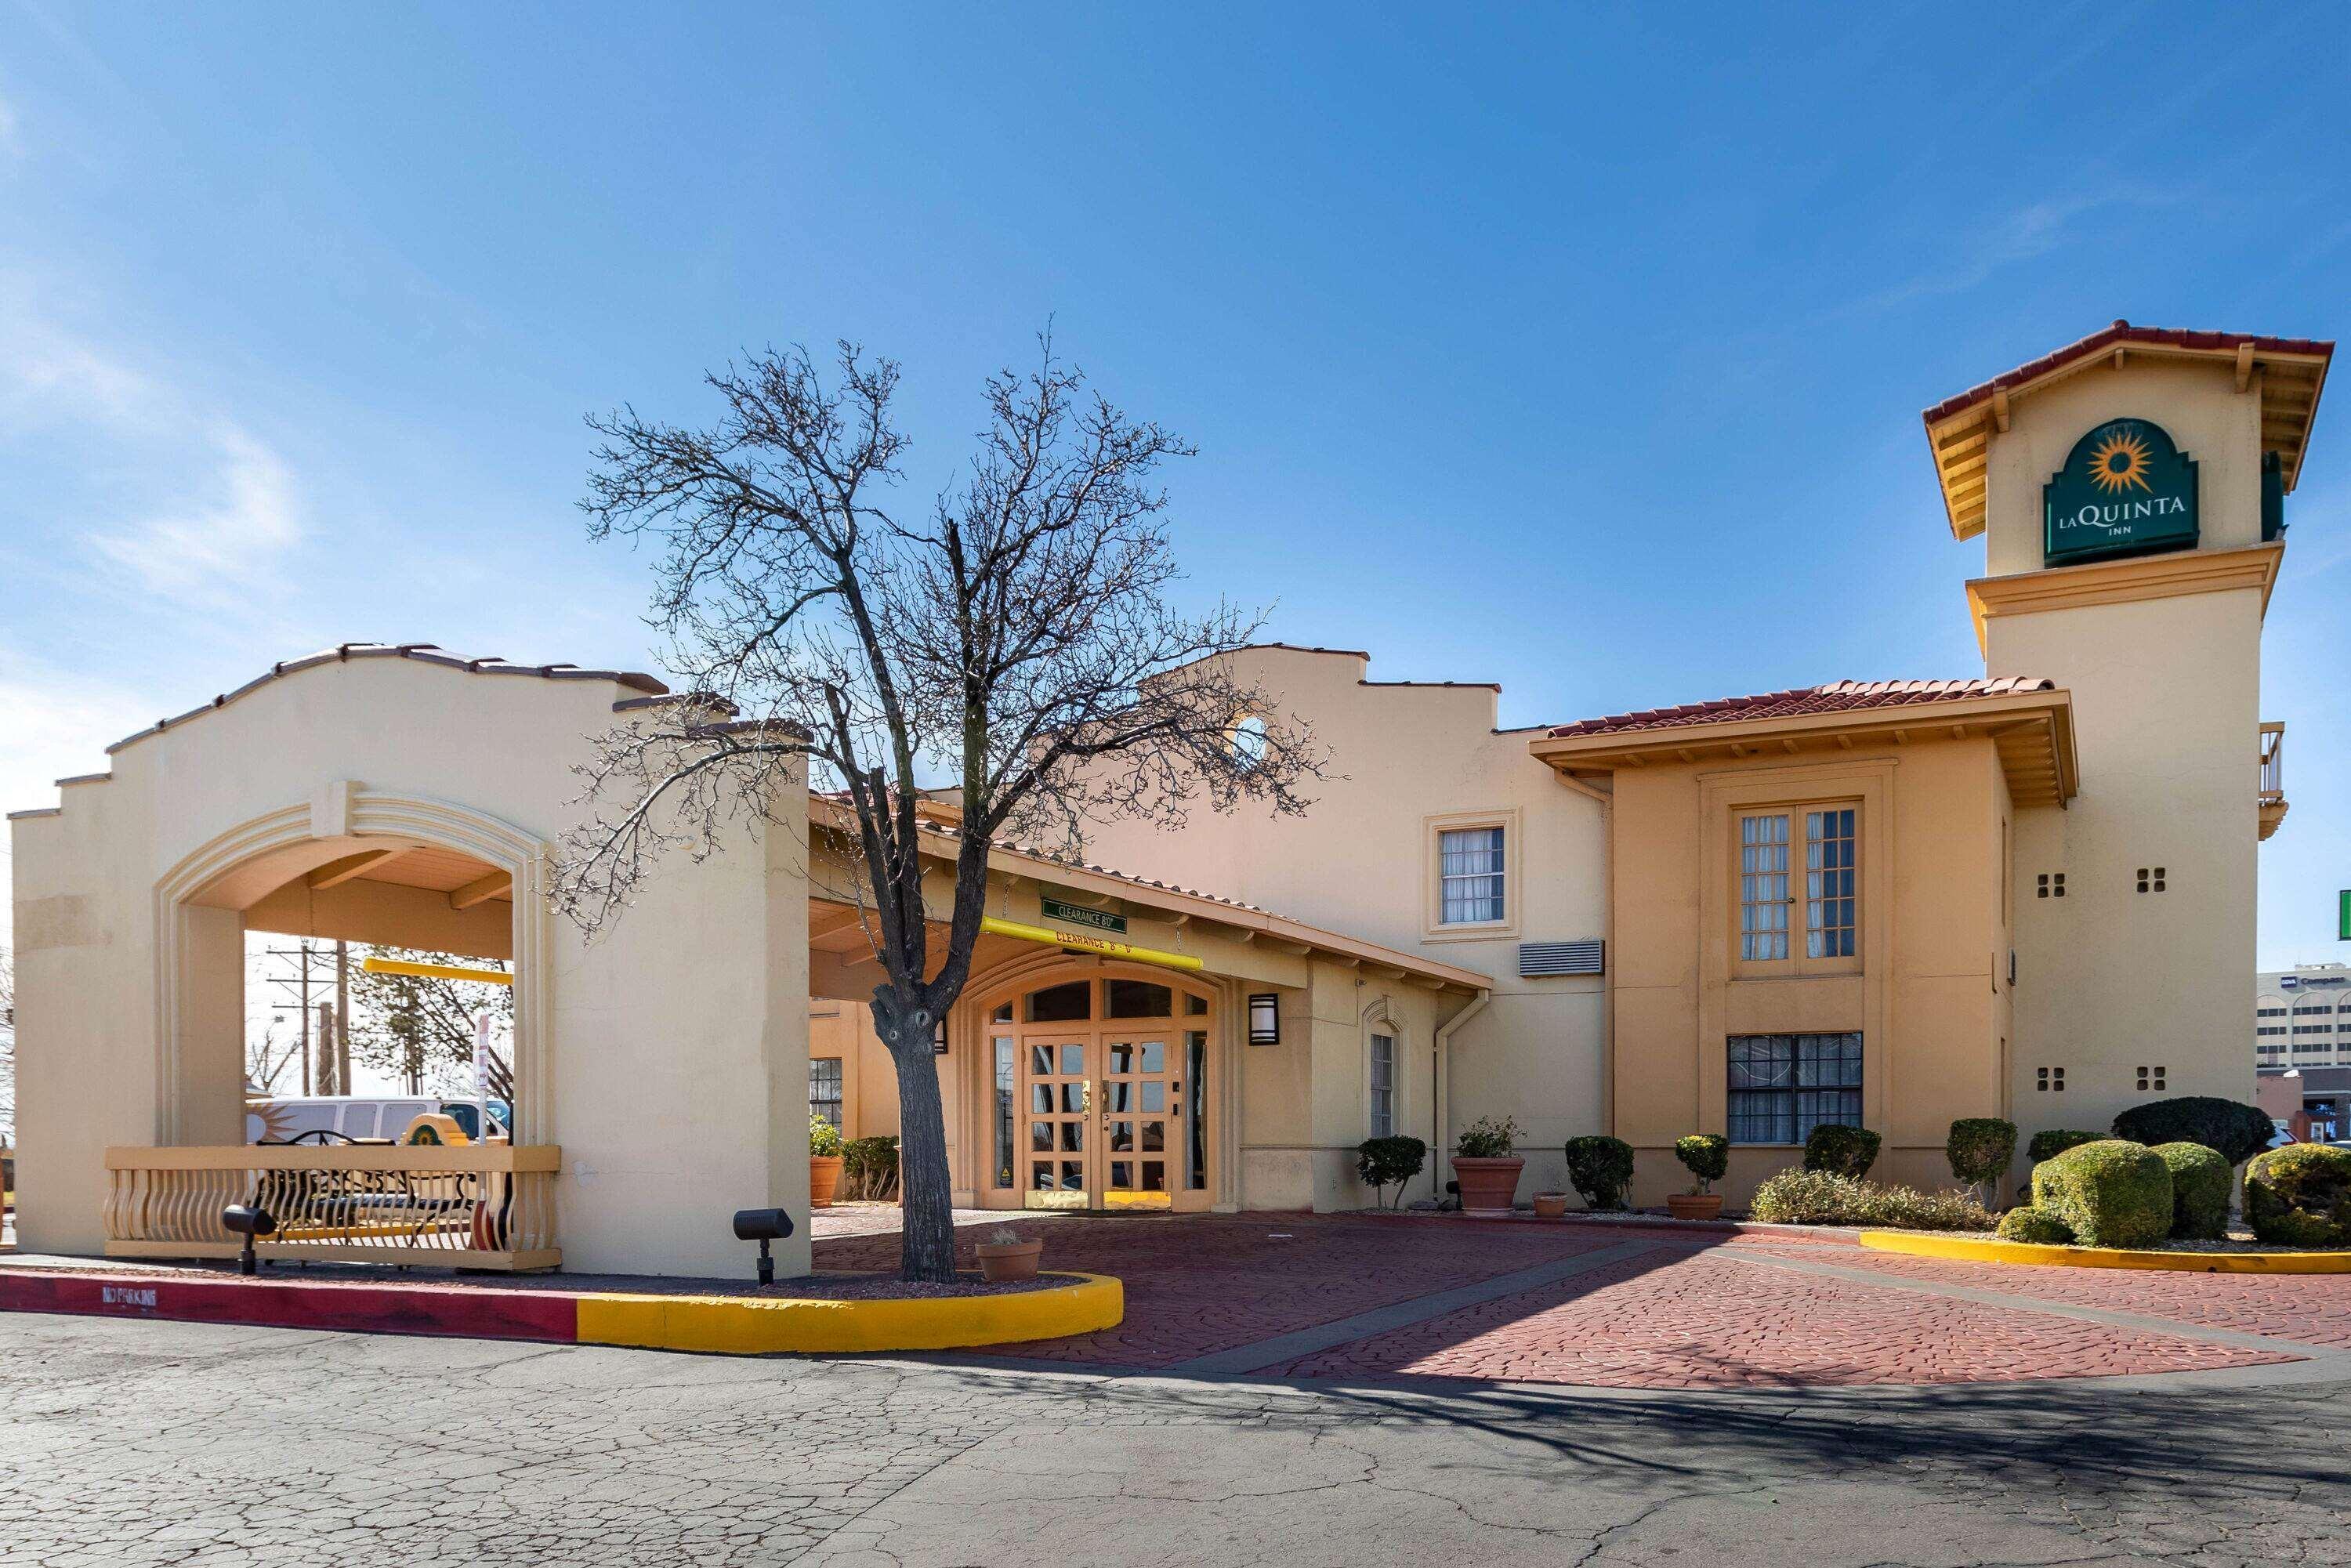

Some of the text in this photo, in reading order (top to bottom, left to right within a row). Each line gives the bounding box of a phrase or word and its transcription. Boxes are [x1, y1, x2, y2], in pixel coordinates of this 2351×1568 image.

[2059, 496, 2186, 529] LA QUINTA
[2109, 526, 2132, 536] INN
[1058, 906, 1100, 925] CLEARANCE
[1056, 931, 1105, 949] CLEARANCE
[103, 1287, 116, 1302] NO
